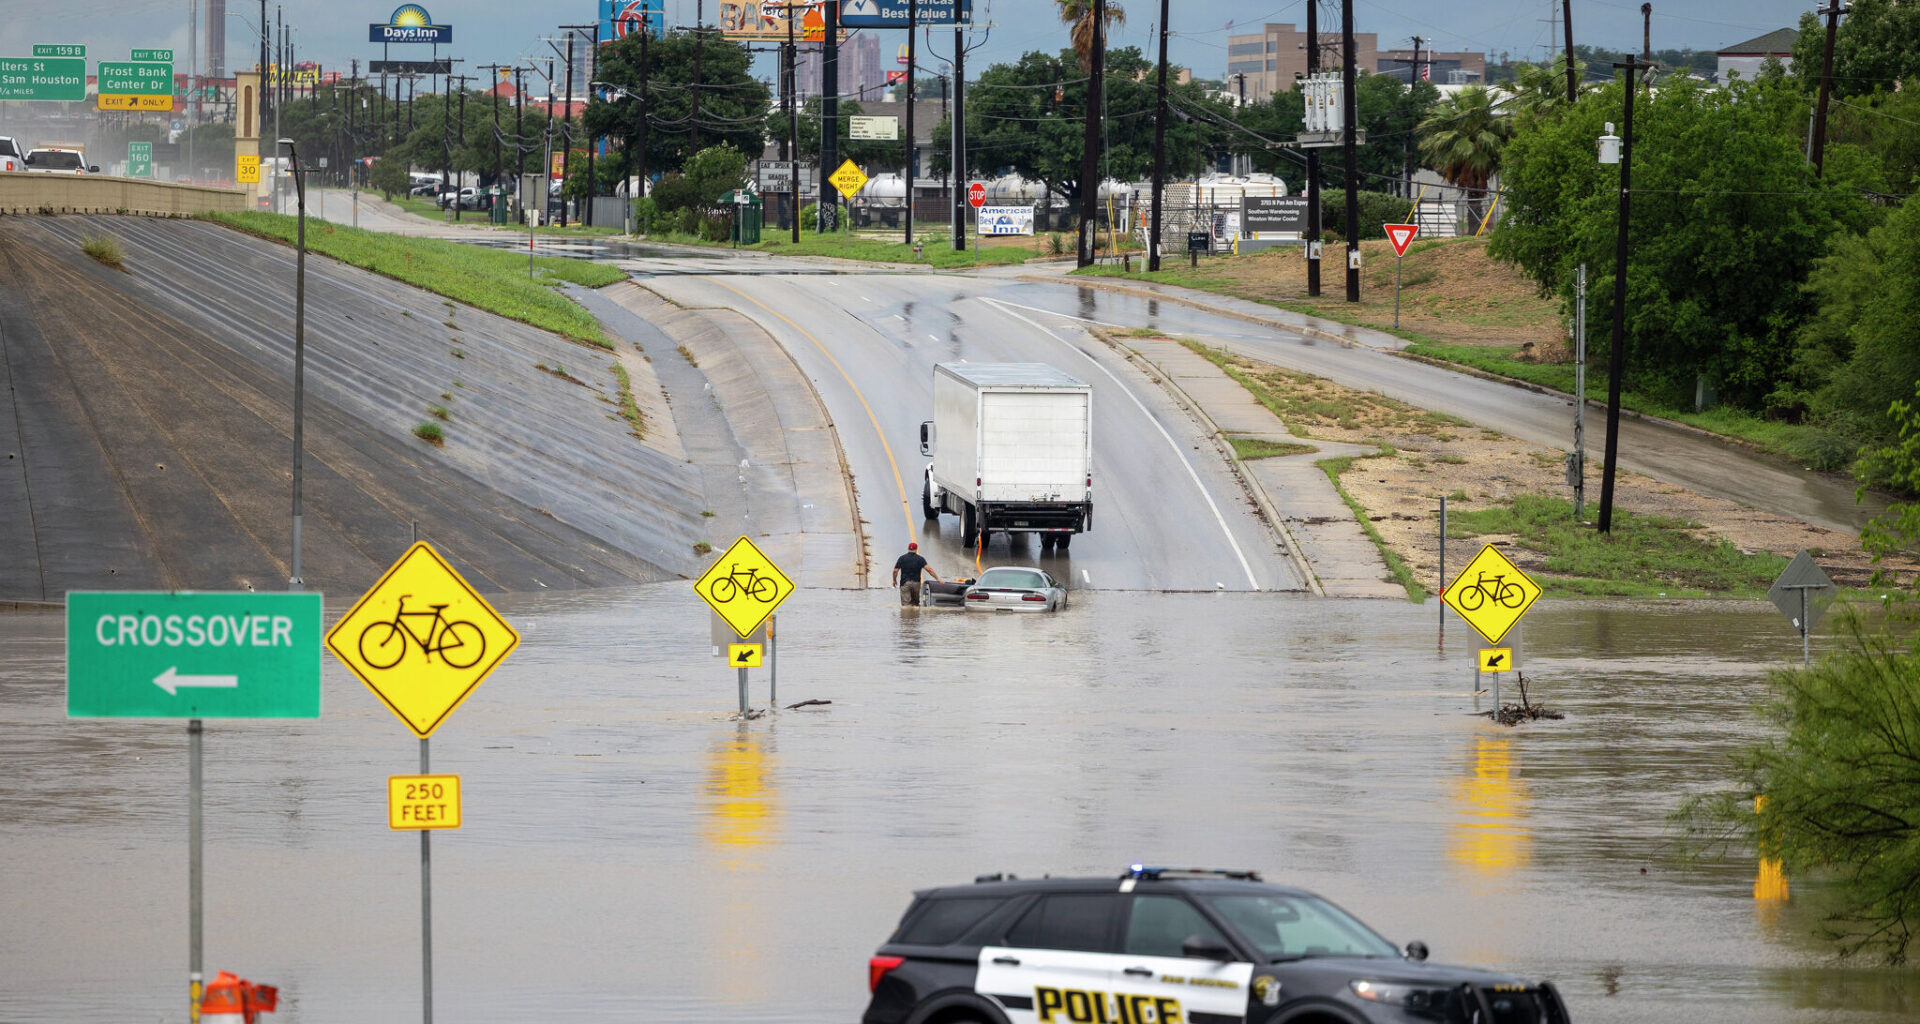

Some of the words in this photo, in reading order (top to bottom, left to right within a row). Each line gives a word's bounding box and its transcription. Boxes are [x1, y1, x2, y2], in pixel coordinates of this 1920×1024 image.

[882, 8, 910, 18] Best
[915, 8, 947, 18] Value
[951, 9, 969, 18] In
[384, 27, 415, 38] Days
[417, 28, 438, 37] Inn
[56, 47, 73, 55] 159
[153, 51, 170, 59] 160
[1, 61, 28, 71] lters
[33, 62, 45, 71] St
[103, 67, 133, 76] Frost
[138, 67, 167, 76] Bank
[2, 75, 26, 84] Sam
[32, 75, 79, 84] Houston
[107, 80, 145, 89] Center
[151, 80, 164, 89] Dr
[131, 153, 149, 162] 160
[241, 166, 256, 175] 30
[969, 190, 985, 200] STOP
[979, 216, 994, 225] Best
[993, 225, 1019, 233] Inn
[96, 615, 294, 647] CROSSOVER
[405, 784, 444, 800] 250
[402, 805, 448, 821] FEET
[1034, 985, 1184, 1024] POLICE
